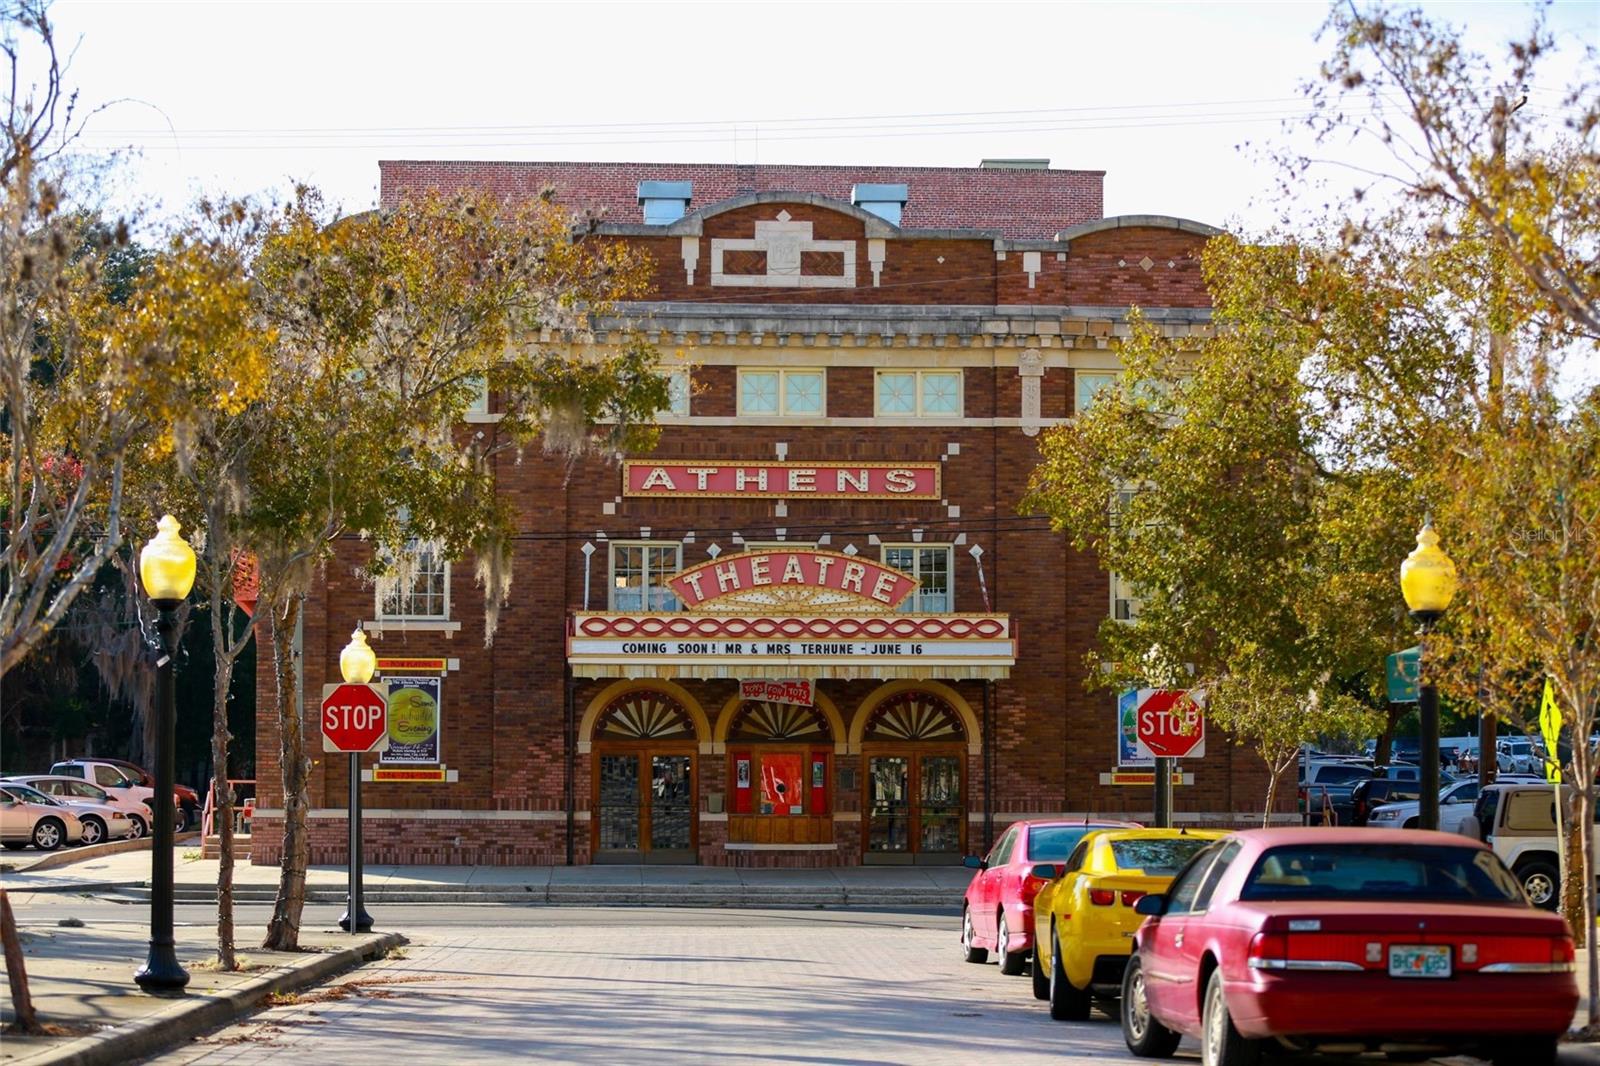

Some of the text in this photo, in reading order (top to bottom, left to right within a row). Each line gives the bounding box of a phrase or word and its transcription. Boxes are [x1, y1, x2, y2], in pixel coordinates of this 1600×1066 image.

[641, 467, 917, 493] ATHENS
[683, 555, 898, 604] THEATRE
[622, 643, 667, 654] COMING
[677, 643, 717, 654] SOON!
[725, 643, 742, 654] MR
[750, 643, 758, 654] &
[766, 643, 791, 654] MRS
[801, 643, 853, 655] TERHUNE
[871, 643, 901, 655] JUNE
[911, 643, 923, 655] 16
[744, 683, 808, 700] TOYS FOR TOTS
[325, 705, 382, 731] STOP
